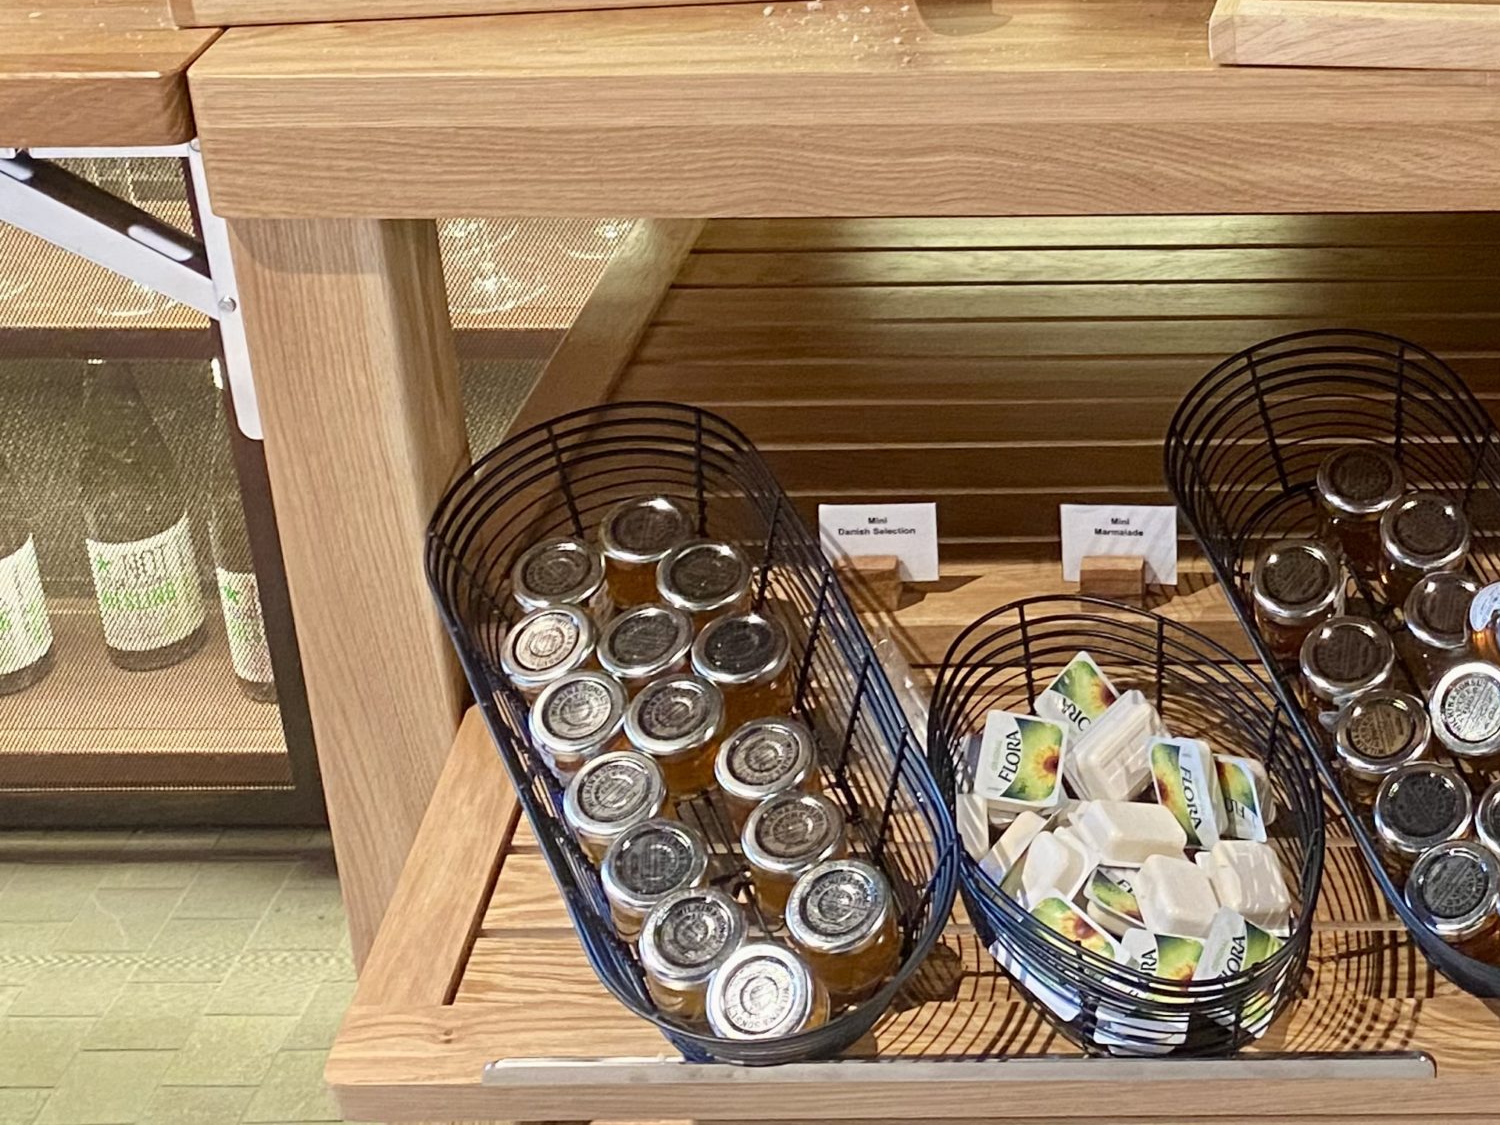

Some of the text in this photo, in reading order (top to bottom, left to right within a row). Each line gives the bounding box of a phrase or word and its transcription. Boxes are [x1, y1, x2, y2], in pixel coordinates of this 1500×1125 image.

[873, 527, 916, 535] Selection
[1094, 528, 1144, 536] Marmalade
[998, 730, 1022, 783] FLORA
[1180, 765, 1202, 830] FLORA
[1225, 797, 1245, 819] FLO
